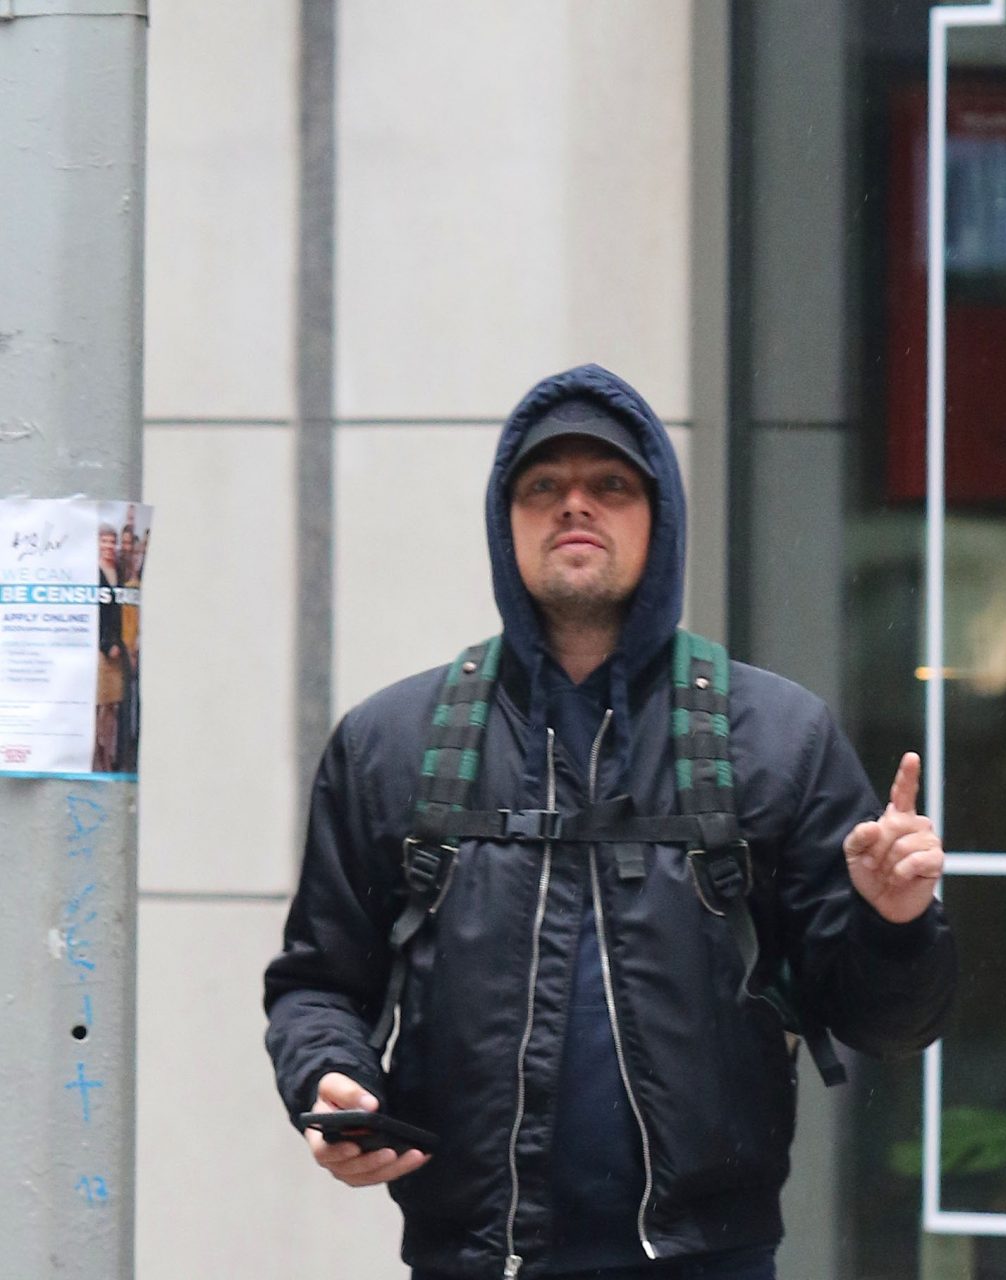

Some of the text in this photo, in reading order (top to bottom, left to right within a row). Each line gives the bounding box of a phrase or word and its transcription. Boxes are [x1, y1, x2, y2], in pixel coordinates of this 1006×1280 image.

[35, 567, 72, 582] CAN
[2, 586, 28, 602] BE
[32, 586, 113, 604] CENSUS
